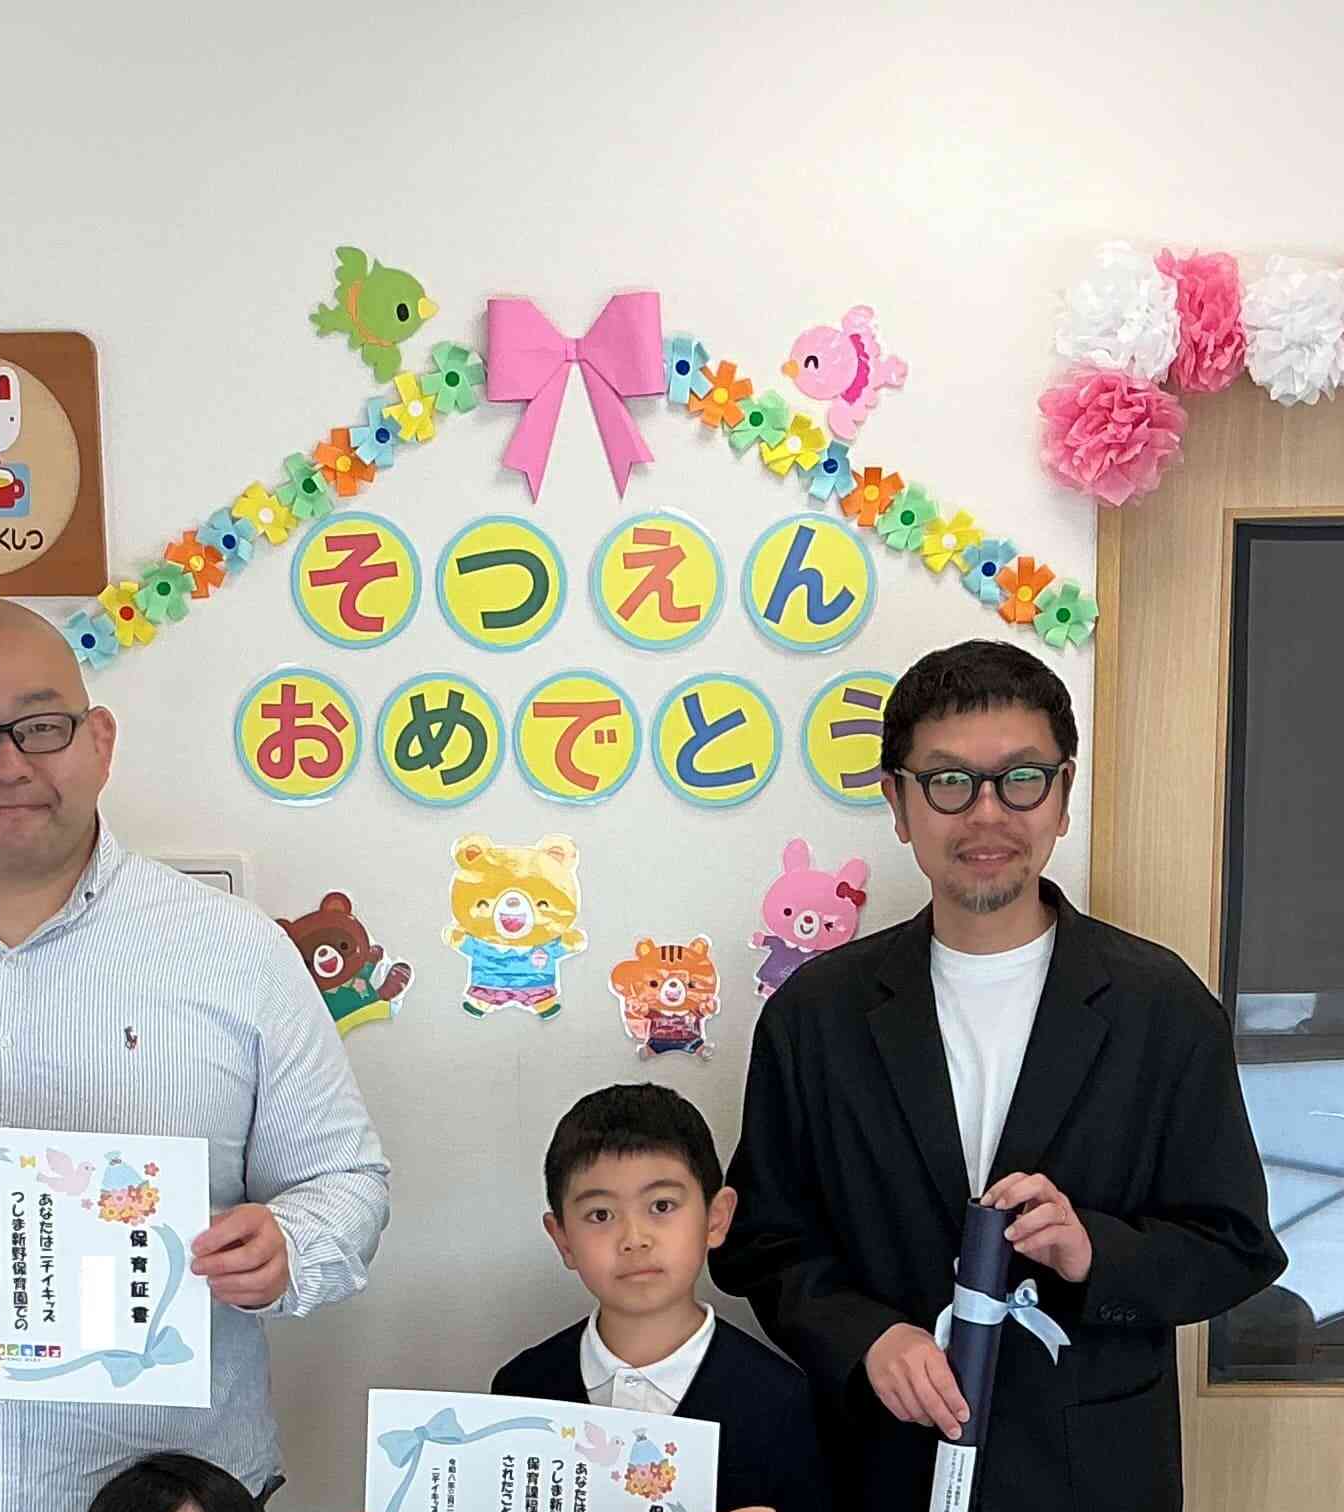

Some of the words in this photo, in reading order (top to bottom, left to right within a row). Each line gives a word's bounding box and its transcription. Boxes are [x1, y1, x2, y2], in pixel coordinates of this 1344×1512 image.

[307, 525, 856, 635] そつえん
[130, 1229, 150, 1323] 保育証書
